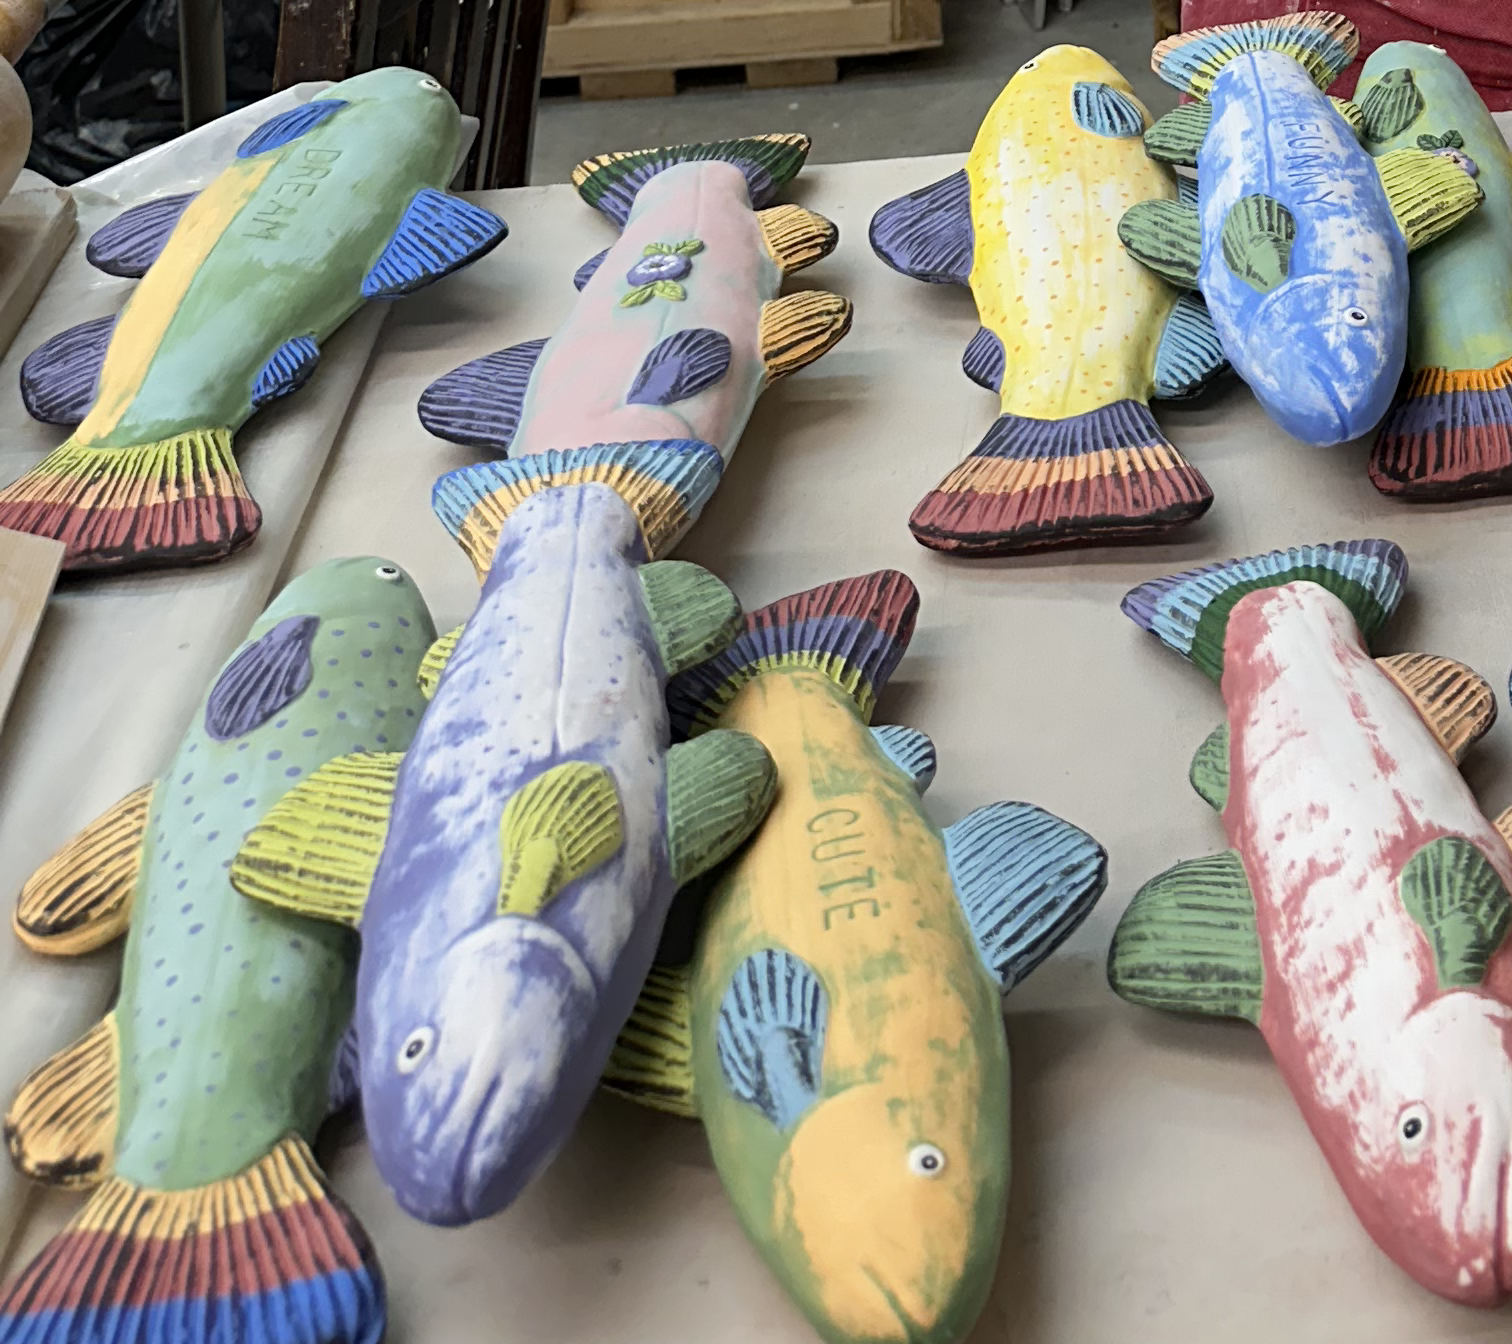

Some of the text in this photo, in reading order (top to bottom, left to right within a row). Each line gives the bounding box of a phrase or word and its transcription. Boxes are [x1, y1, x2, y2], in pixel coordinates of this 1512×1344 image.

[242, 149, 343, 240] DREAM
[1282, 122, 1338, 207] FUNNY
[807, 808, 880, 931] CUTE
